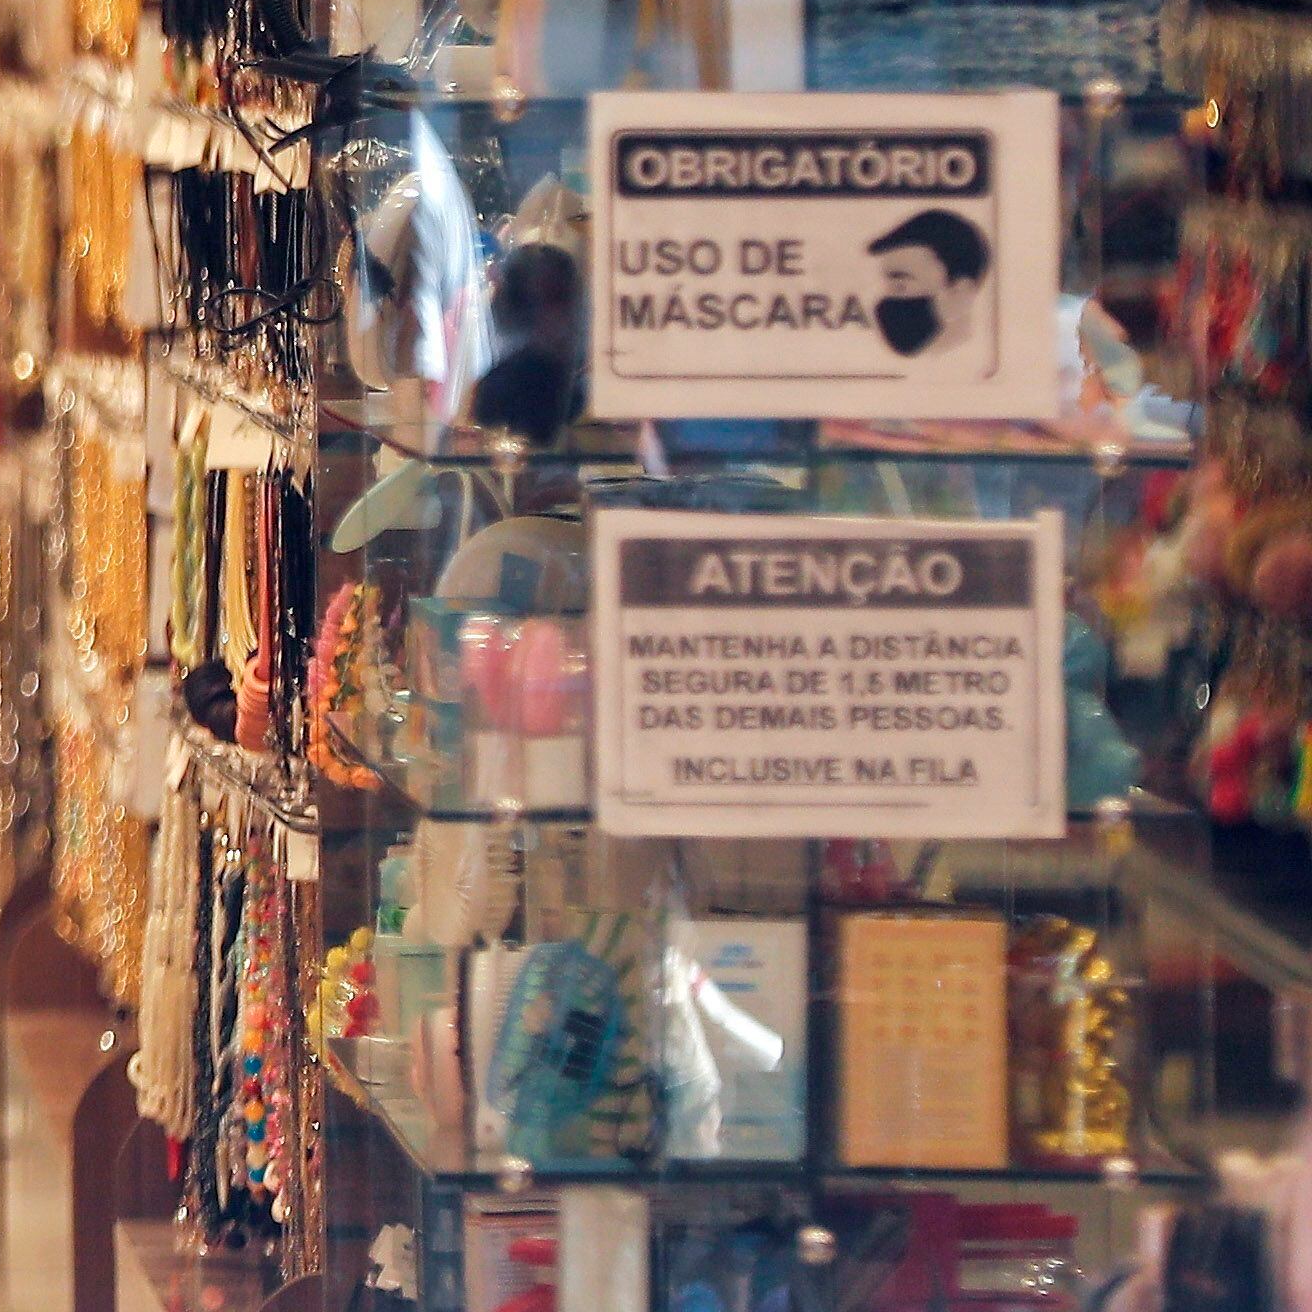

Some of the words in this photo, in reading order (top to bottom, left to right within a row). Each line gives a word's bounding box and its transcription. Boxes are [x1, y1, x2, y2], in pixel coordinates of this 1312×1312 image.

[631, 141, 977, 189] OBRIGATÓRIO
[620, 240, 721, 276] USO
[741, 240, 806, 276] DE
[620, 284, 873, 331] MÁSCARA
[692, 545, 964, 605] ATENÇÃO
[629, 636, 805, 659] MANTENHA
[818, 635, 838, 659] A
[850, 629, 1023, 660] DISTÂNCIA
[641, 670, 773, 695] SEGURA
[786, 670, 827, 694] DE
[895, 669, 1010, 695] METRO
[640, 706, 704, 731] DAS
[715, 706, 837, 730] DEMAIS
[674, 757, 842, 783] INCLUSIVE
[856, 757, 897, 783] NA
[910, 757, 978, 784] FILA
